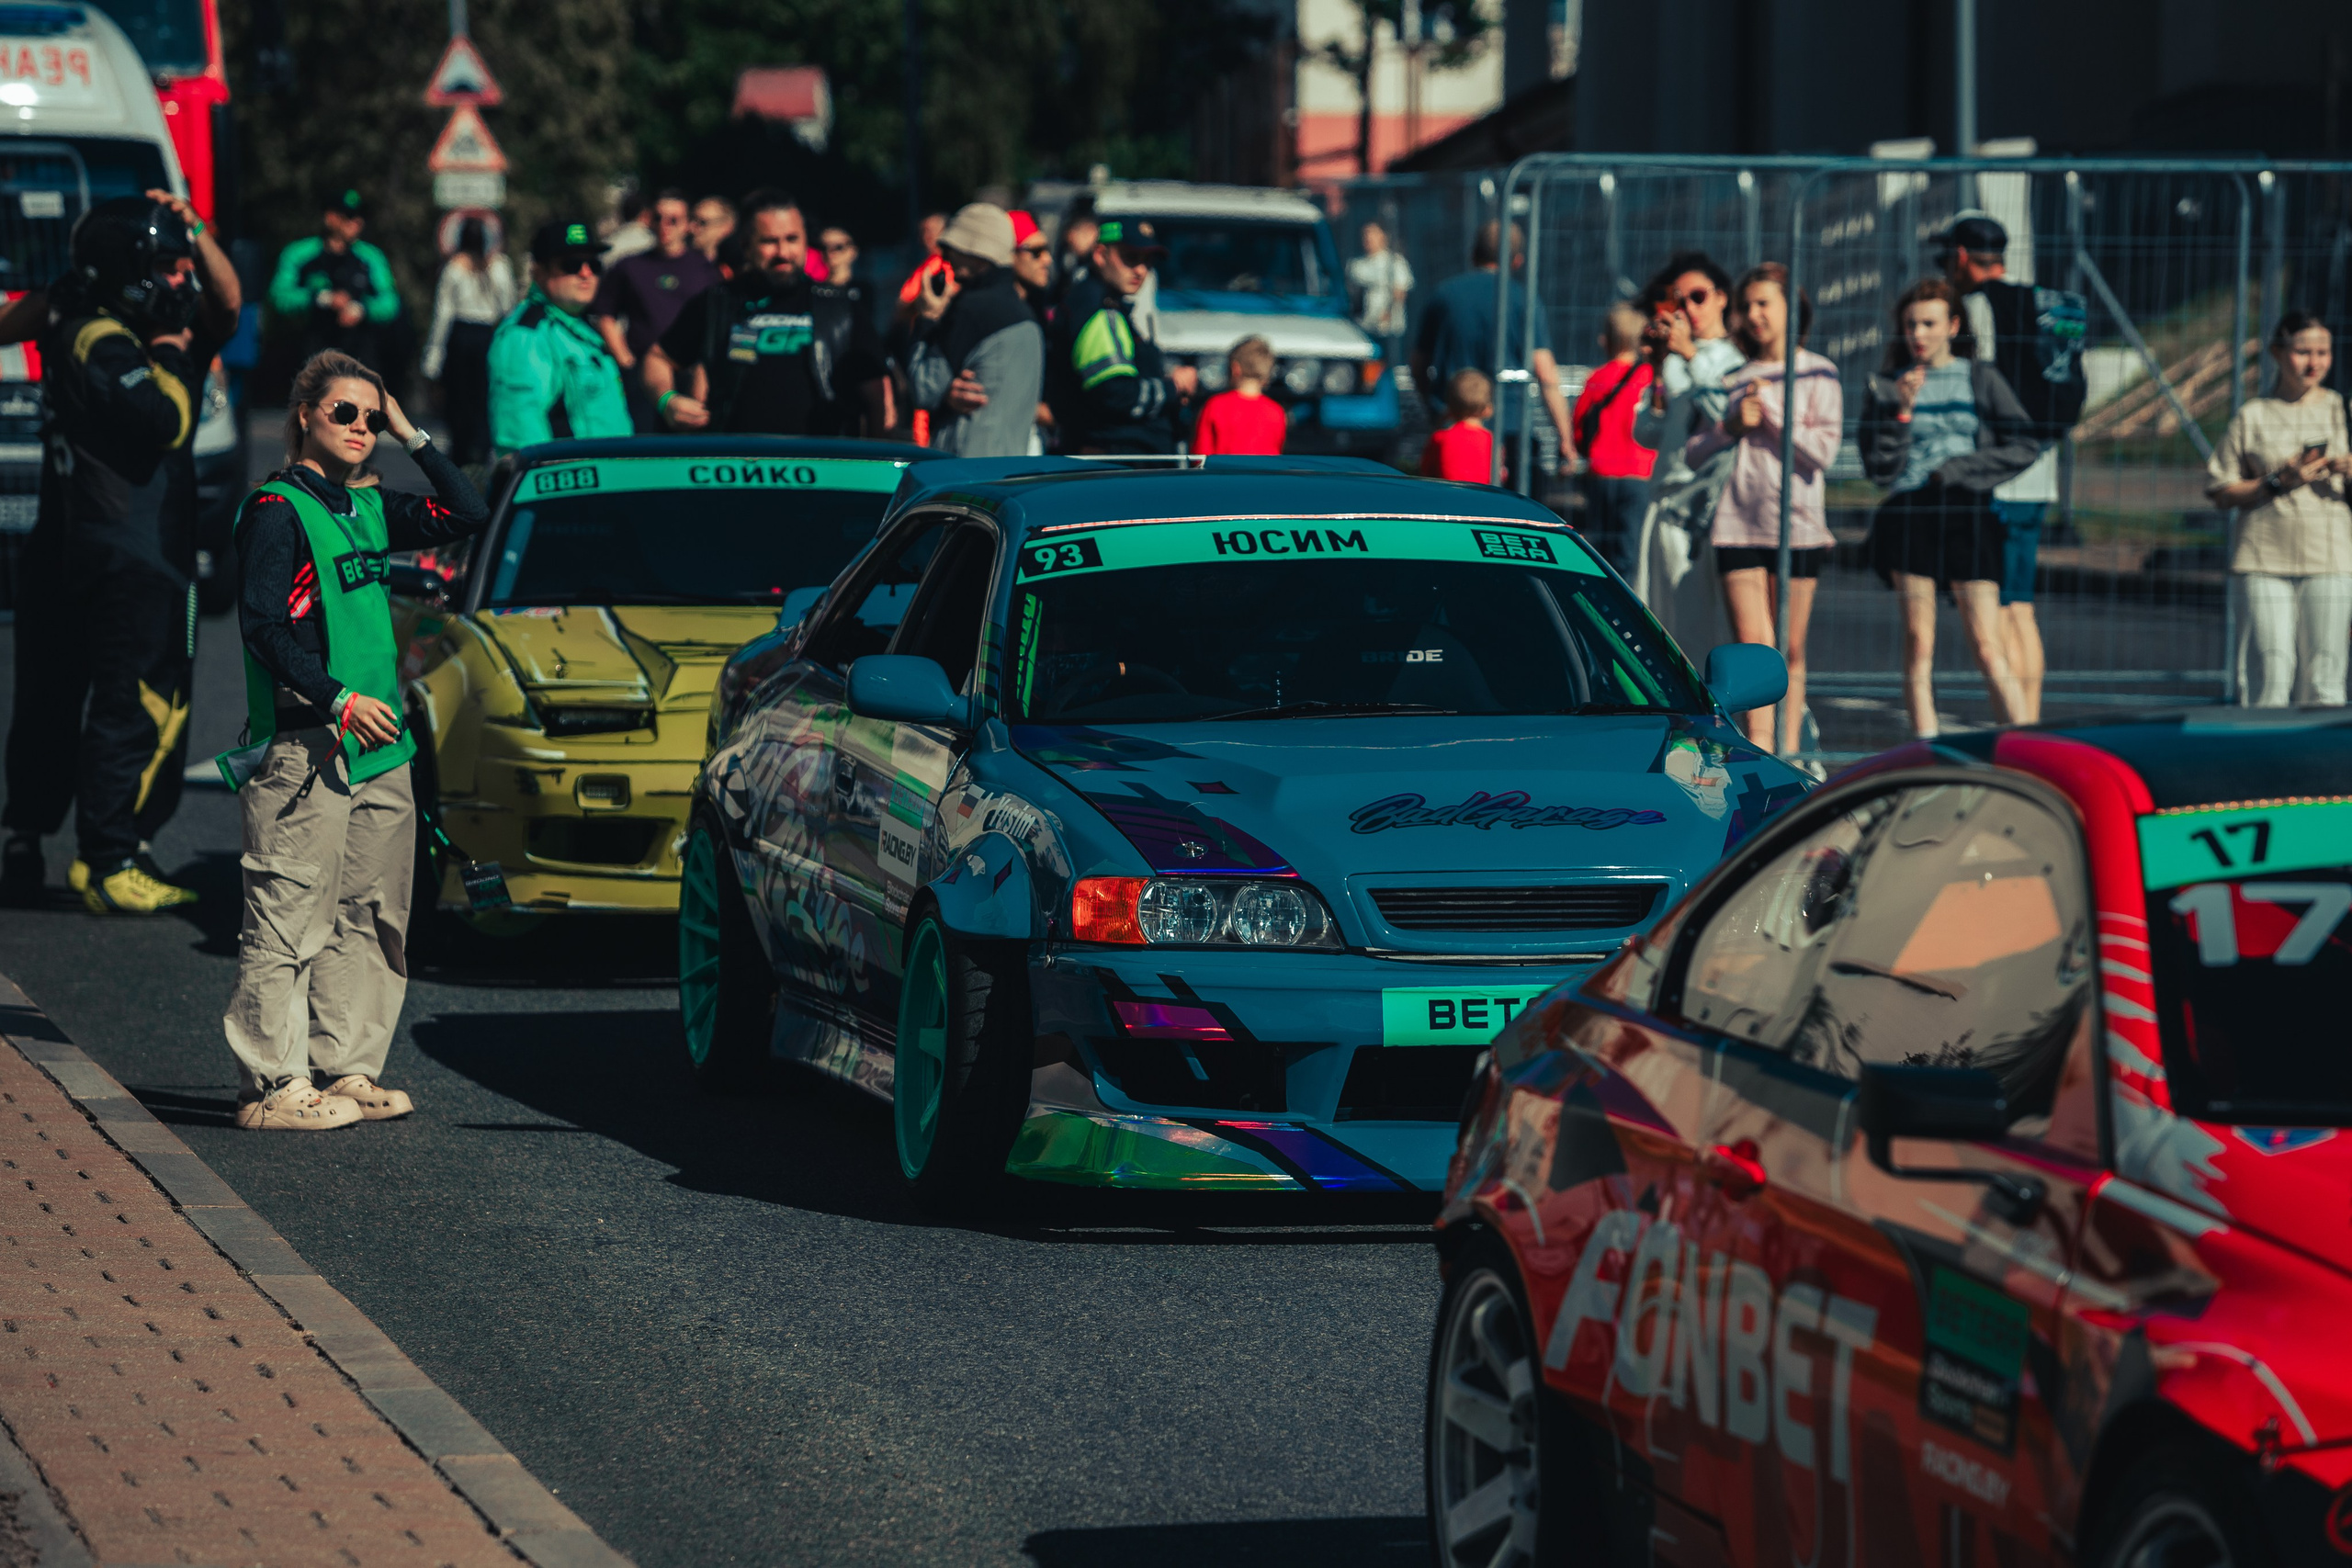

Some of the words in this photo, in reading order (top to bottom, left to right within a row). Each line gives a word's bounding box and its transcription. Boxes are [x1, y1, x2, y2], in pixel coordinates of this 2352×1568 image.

[537, 467, 596, 493] 888
[689, 461, 816, 485] СОЙКО
[1034, 543, 1085, 571] 93
[1212, 529, 1370, 556] ЮСИМ
[989, 795, 1036, 840] Yusim
[2189, 818, 2271, 867] 17
[2168, 880, 2352, 968] 17
[1544, 1209, 1879, 1483] FONBET
